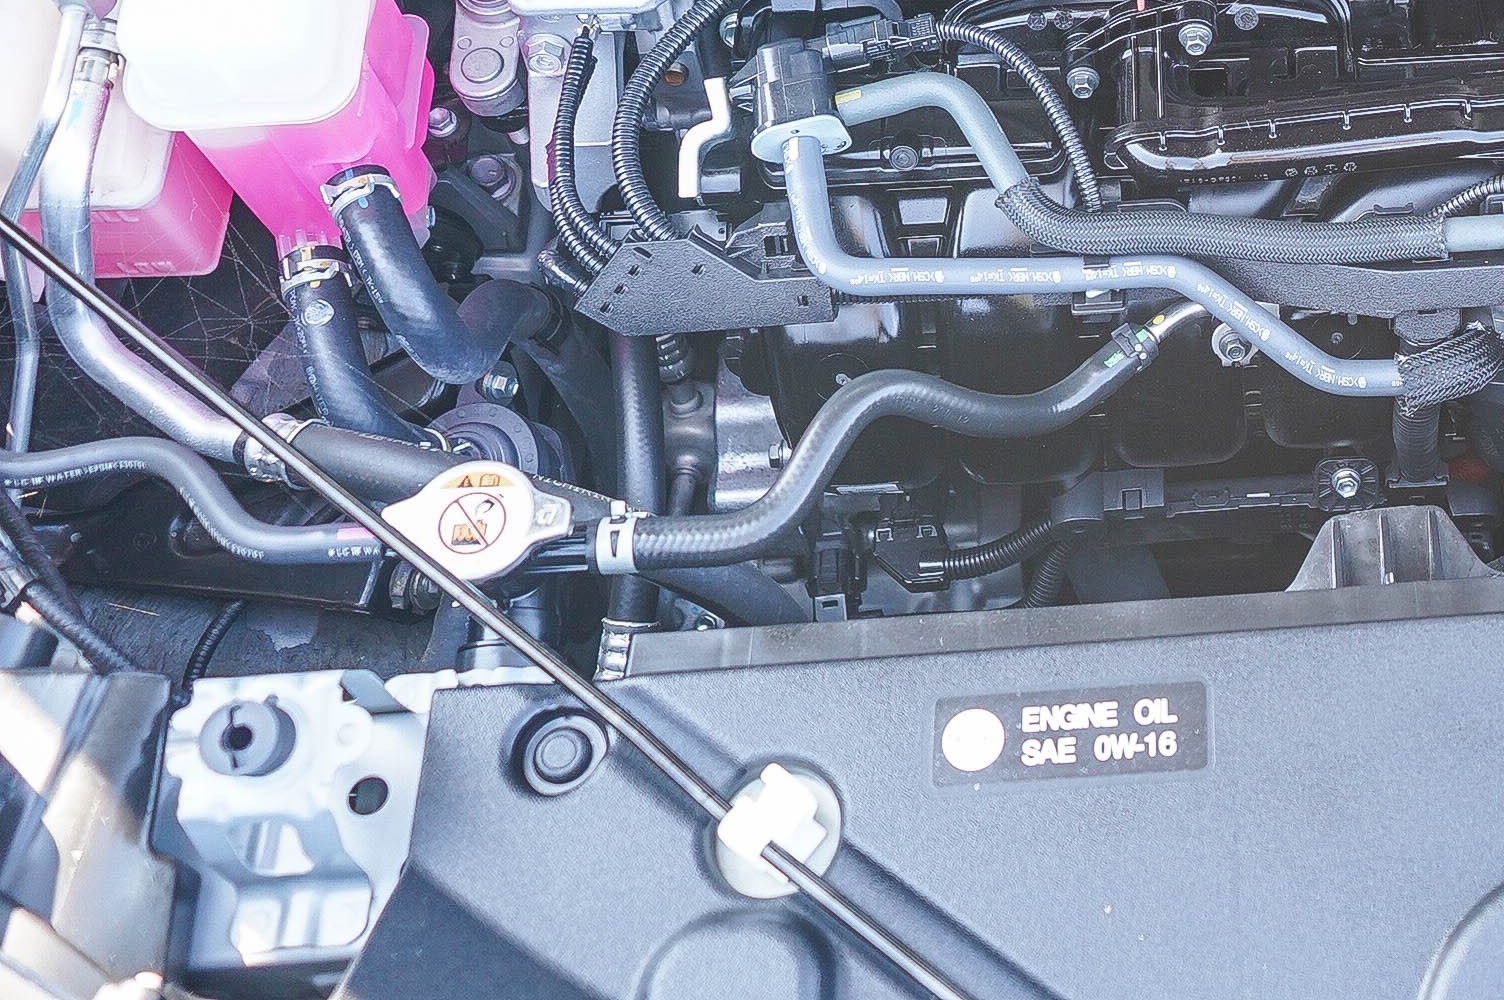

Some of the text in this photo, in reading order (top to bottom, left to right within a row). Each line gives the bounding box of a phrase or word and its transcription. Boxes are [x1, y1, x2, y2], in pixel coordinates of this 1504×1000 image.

[1020, 697, 1179, 733] ENGINE OIL
[1020, 729, 1178, 767] SAE 0W-16
